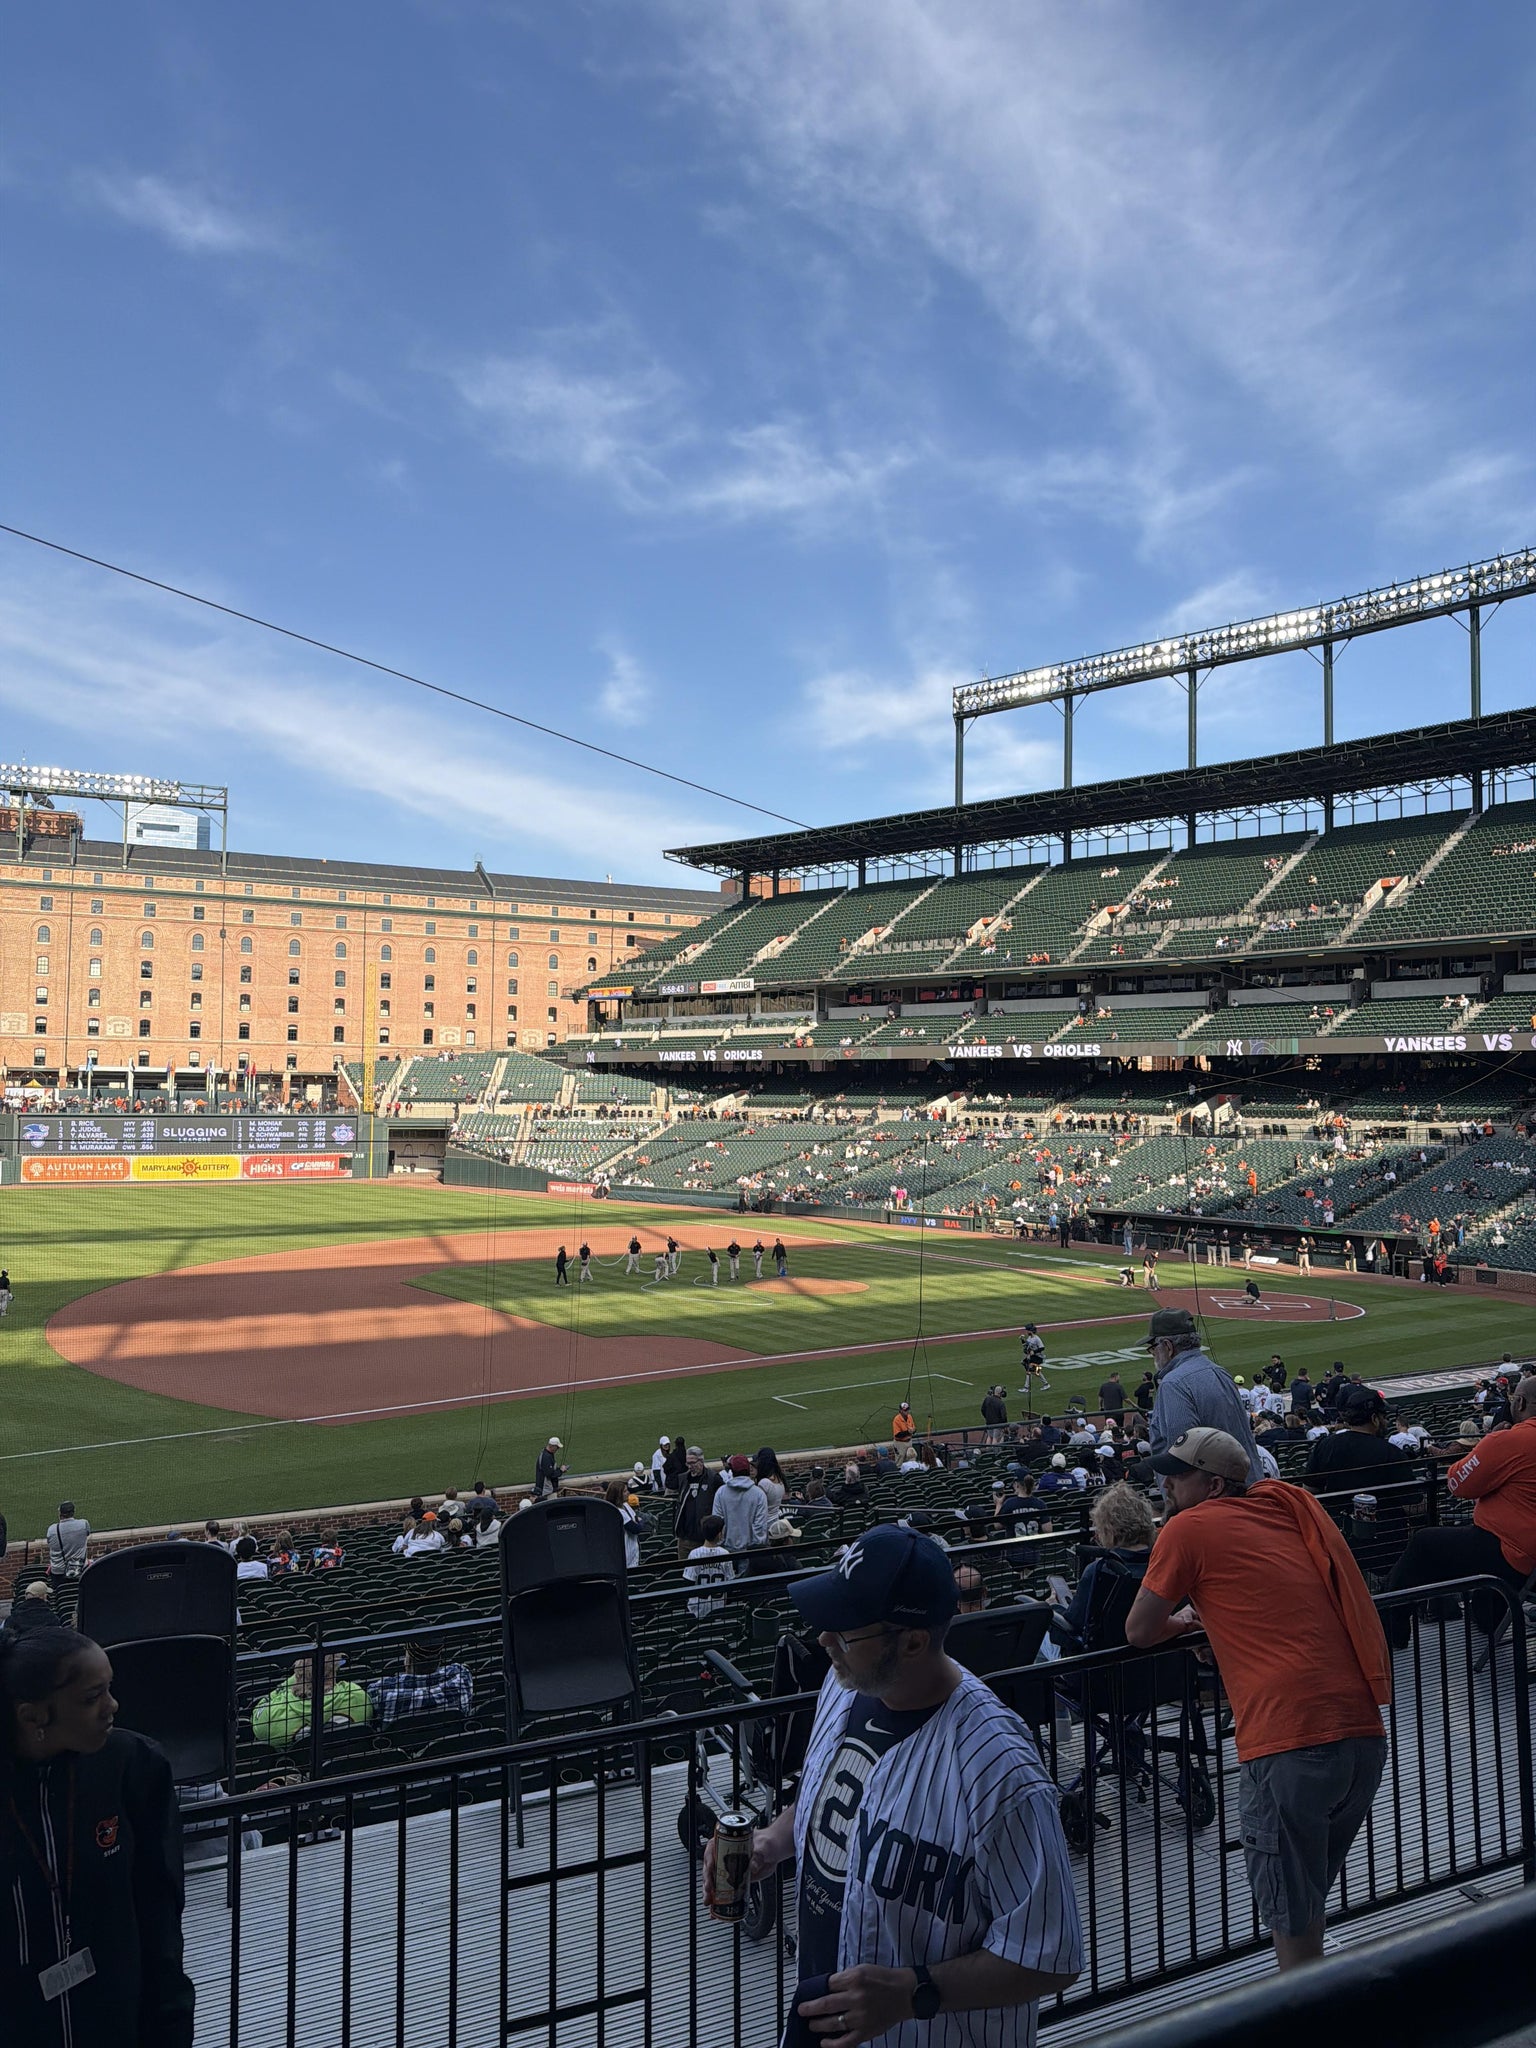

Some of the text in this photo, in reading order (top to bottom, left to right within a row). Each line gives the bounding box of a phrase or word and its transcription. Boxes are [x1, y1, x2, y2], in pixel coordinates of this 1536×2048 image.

[662, 985, 685, 993] 5:58:43
[1226, 1039, 1243, 1056] NY
[1384, 1036, 1467, 1051] YANKEES
[1483, 1034, 1513, 1051] VS
[659, 1050, 763, 1061] YANKEES VS ORIOLES
[948, 1044, 1101, 1057] YANKEES VS ORIOLES
[163, 1128, 227, 1137] SLUGGING
[142, 1164, 181, 1172] MARYLAND
[250, 1162, 283, 1175] HIGH'S
[550, 1184, 565, 1192] weis
[900, 1216, 961, 1228] NYY VS BAL
[1043, 1346, 1154, 1370] GEIC
[1275, 1403, 1282, 1414] 2
[839, 1541, 864, 1580] NY
[819, 1769, 864, 1853] 2
[857, 1808, 976, 1924] YORK
[806, 1875, 822, 1896] York
